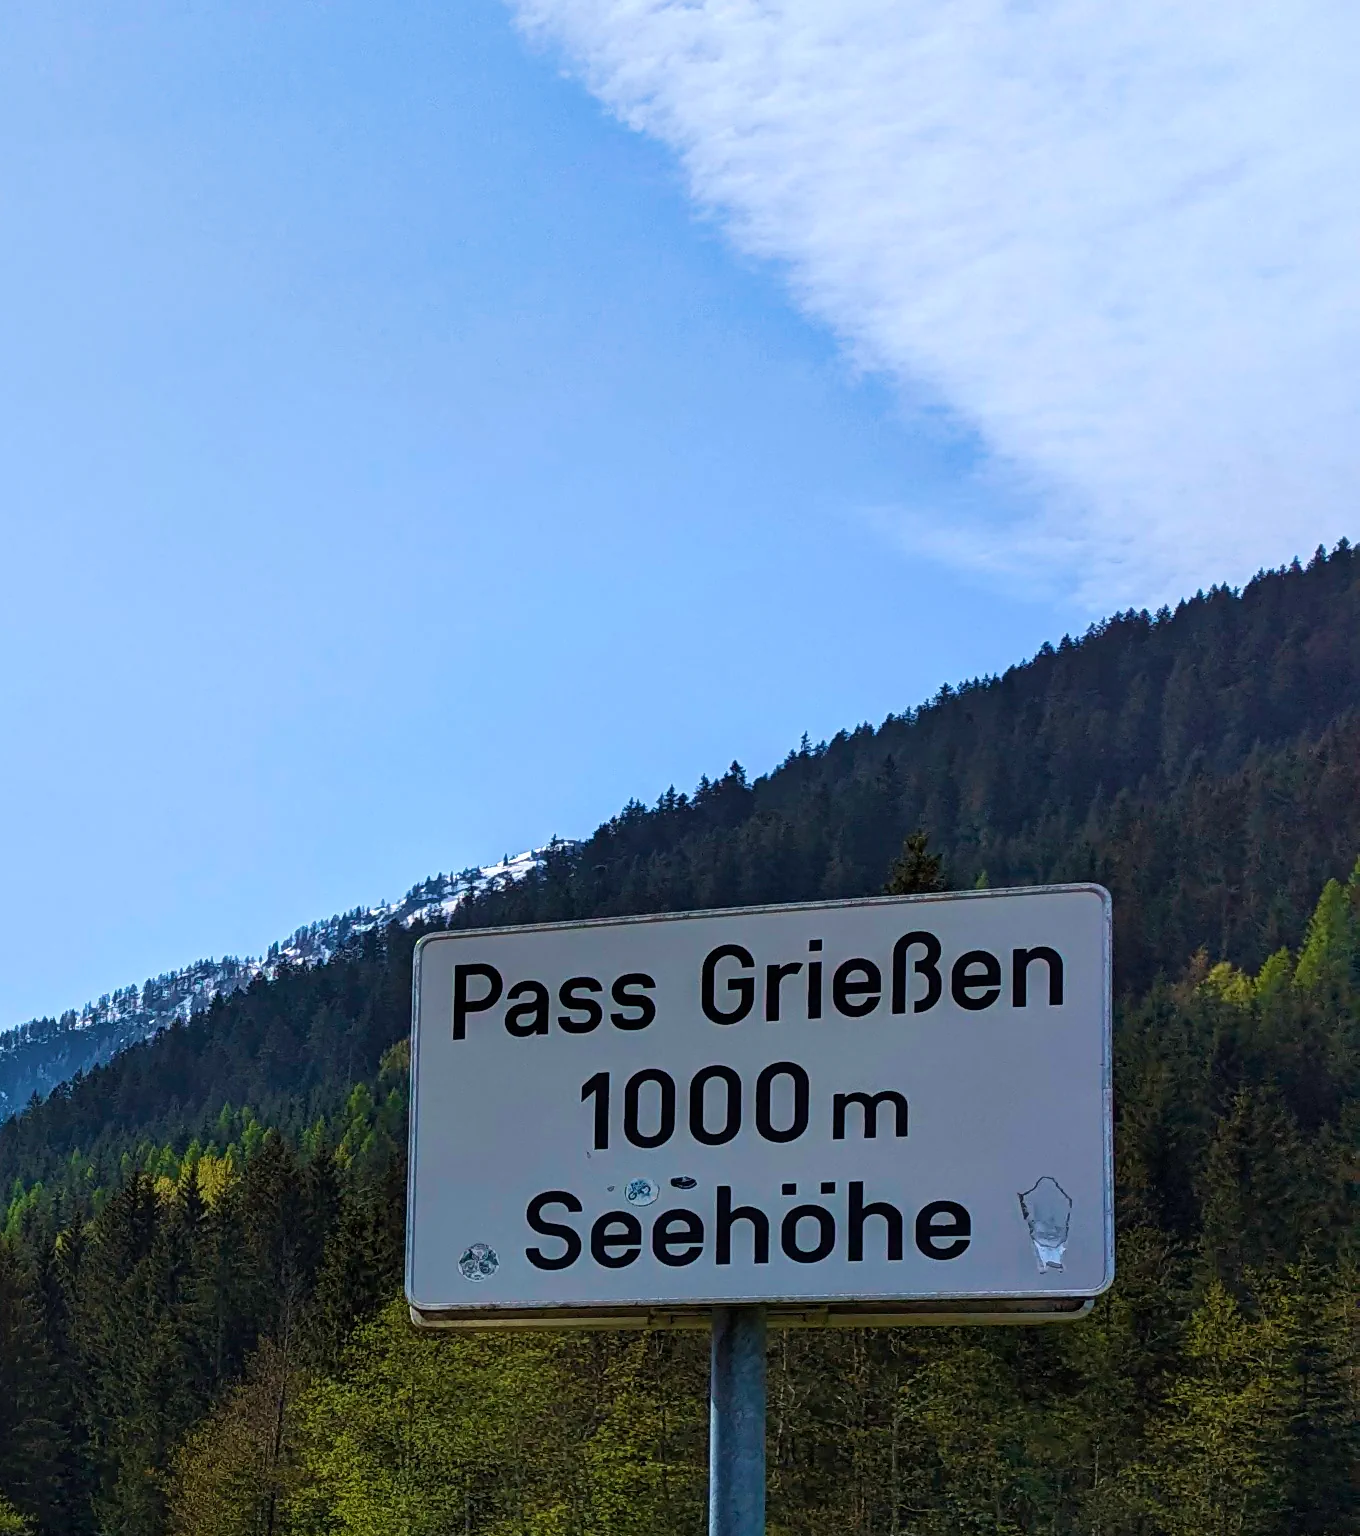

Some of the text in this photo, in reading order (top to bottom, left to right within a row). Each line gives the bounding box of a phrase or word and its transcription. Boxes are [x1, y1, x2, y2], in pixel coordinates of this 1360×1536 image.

[451, 930, 1065, 1041] Pass Grießen
[580, 1060, 909, 1151] 1000 m
[524, 1180, 972, 1272] Seehöhe
